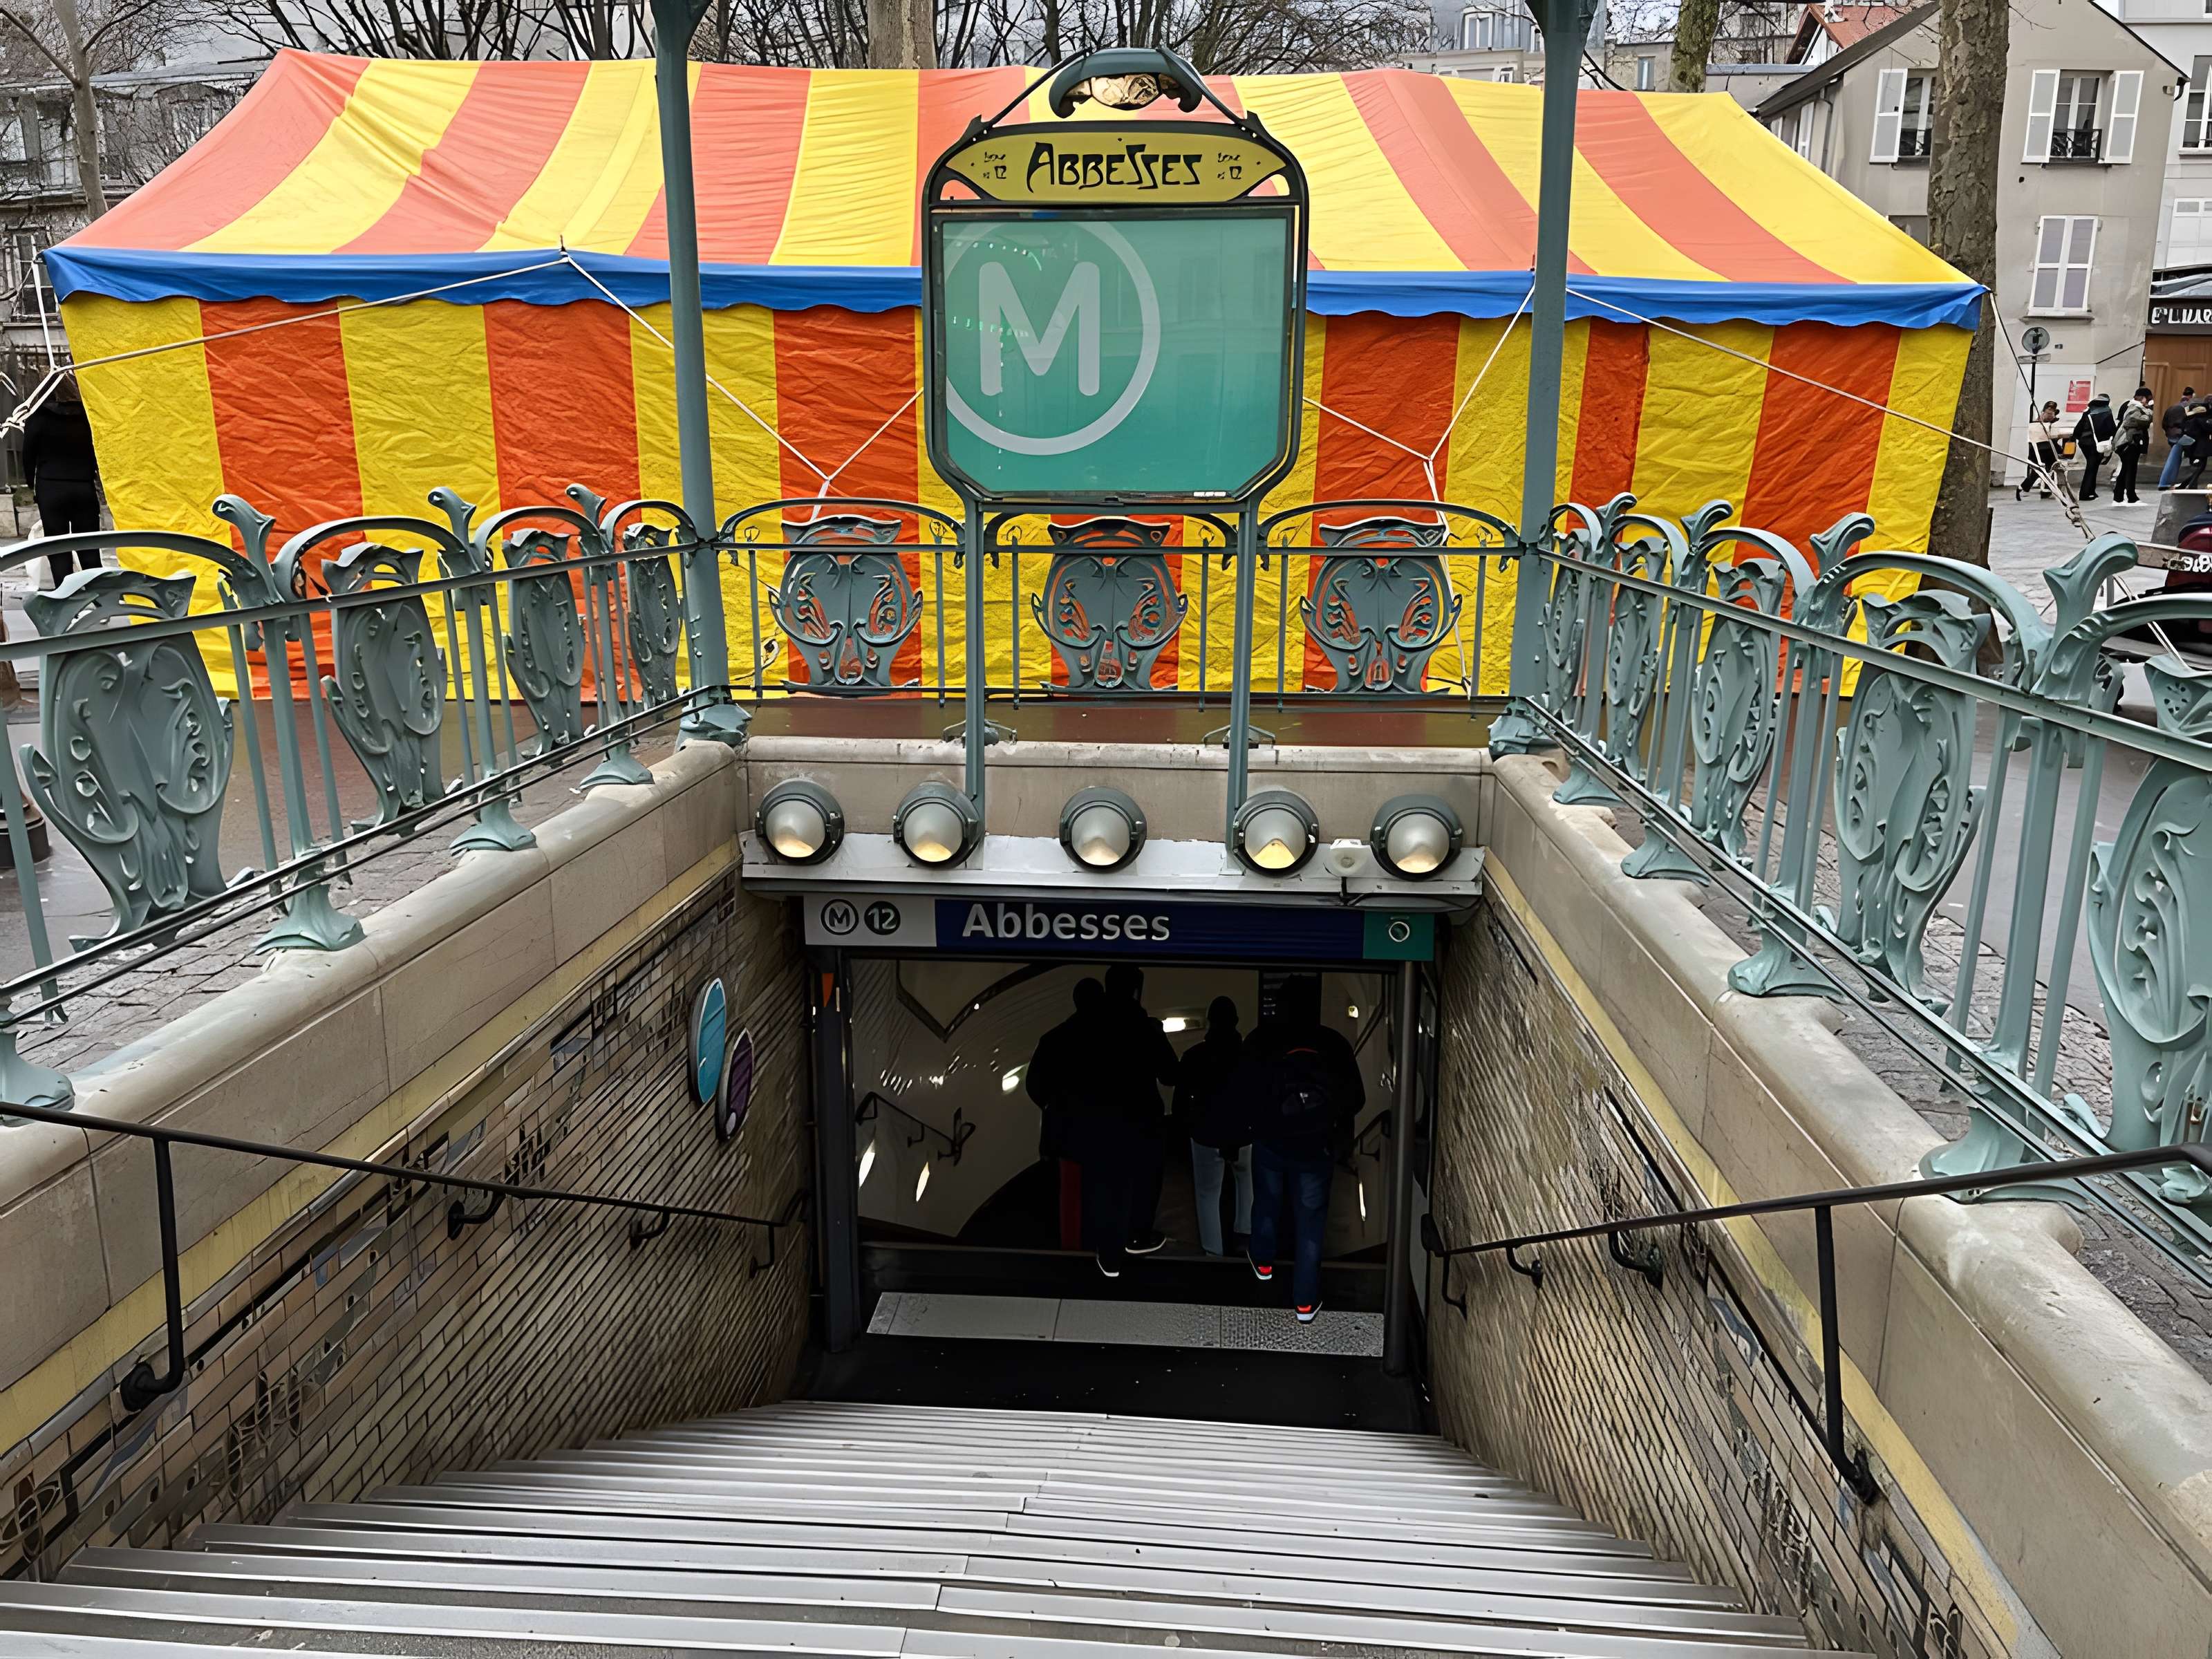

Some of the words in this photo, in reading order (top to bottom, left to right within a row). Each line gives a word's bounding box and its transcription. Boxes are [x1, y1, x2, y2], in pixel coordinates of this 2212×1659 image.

[1027, 142, 1202, 193] ABBESSES
[980, 262, 1100, 396] M
[868, 907, 897, 930] 12
[962, 902, 1170, 941] Abbesses
